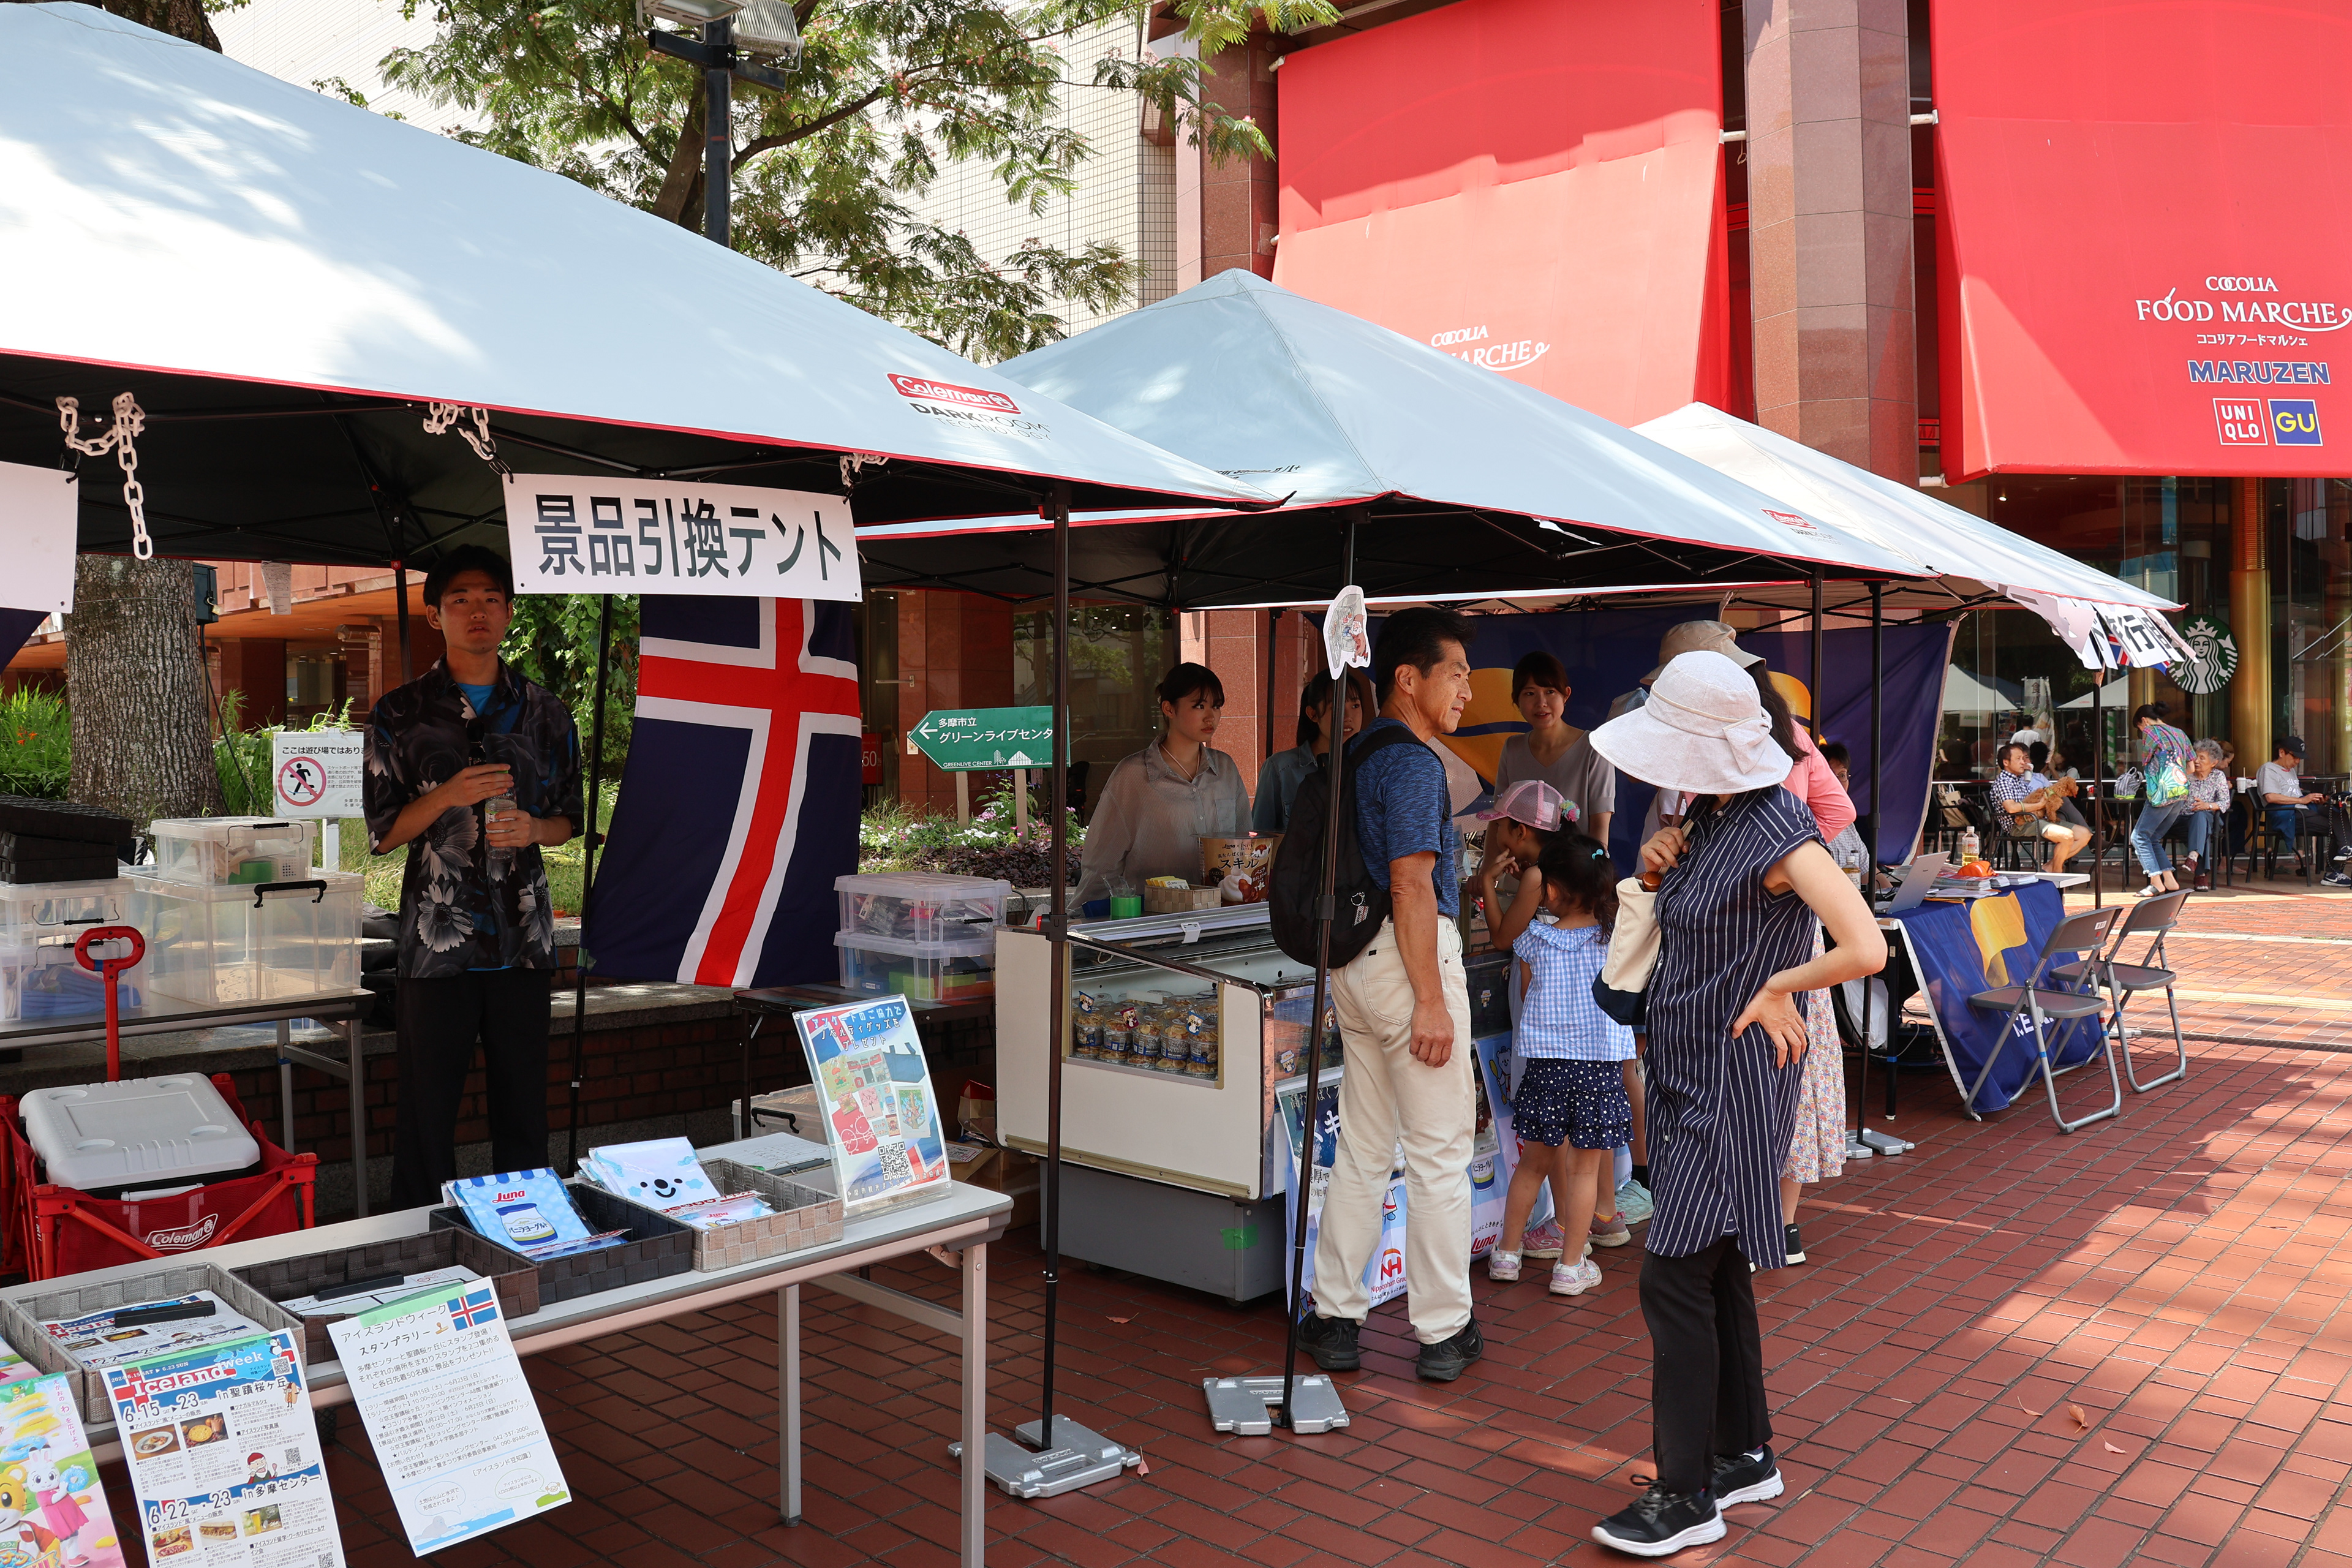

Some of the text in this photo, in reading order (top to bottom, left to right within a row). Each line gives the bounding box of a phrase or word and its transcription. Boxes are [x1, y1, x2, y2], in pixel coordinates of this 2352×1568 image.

[2206, 276, 2278, 292] COCOLIA
[2136, 294, 2352, 332] FOOD MARCHE
[1431, 325, 1488, 347] COCOLIA
[2196, 334, 2309, 346] ココリアフードマルシェ
[1451, 340, 1550, 371] ARCHE
[2187, 360, 2331, 385] MARUZEN
[896, 377, 992, 405] Coleman
[2221, 405, 2255, 420] UNI
[2275, 412, 2315, 432] GU
[934, 417, 1051, 441] TECHNOLOGY
[2225, 423, 2260, 440] QLO
[534, 494, 841, 581] 景品引換テント
[938, 717, 977, 728] 多摩市立
[1218, 858, 1259, 869] スキル
[811, 1004, 903, 1030] アンケートのご協力で
[820, 1017, 900, 1041] ノベルティグッズを
[841, 1033, 888, 1052] プレゼント
[492, 1190, 525, 1203] Luna
[152, 1227, 204, 1245] Coleman
[509, 1222, 548, 1234] バニラヨーグルト
[1471, 1234, 1498, 1254] Luna
[1371, 1280, 1396, 1293] Nipponham
[55, 1319, 115, 1336] Icela
[341, 1303, 448, 1344] アイスランドウィーク
[358, 1327, 432, 1357] スタンプラリー
[249, 1363, 271, 1371] アイスランド
[358, 1333, 500, 1385] それぞれの場所をまわりスタンプを2コ集める
[130, 1351, 263, 1397] Iceland week
[123, 1401, 160, 1423] 6.15
[177, 1393, 199, 1410] 23
[234, 1398, 267, 1410] ツナガルマルシェ
[53, 1380, 80, 1449] えがおの わ を広げよう
[241, 1422, 279, 1435] アイスランド写真展
[492, 1425, 529, 1441] 042-337-2000
[500, 1429, 539, 1447] 090-8946-9909
[502, 1474, 532, 1488] アイスランドには
[148, 1499, 189, 1525] 6.22
[209, 1490, 232, 1509] 23
[241, 1473, 320, 1500] in多摩センター
[418, 1486, 460, 1506] 土地は火山と氷河で
